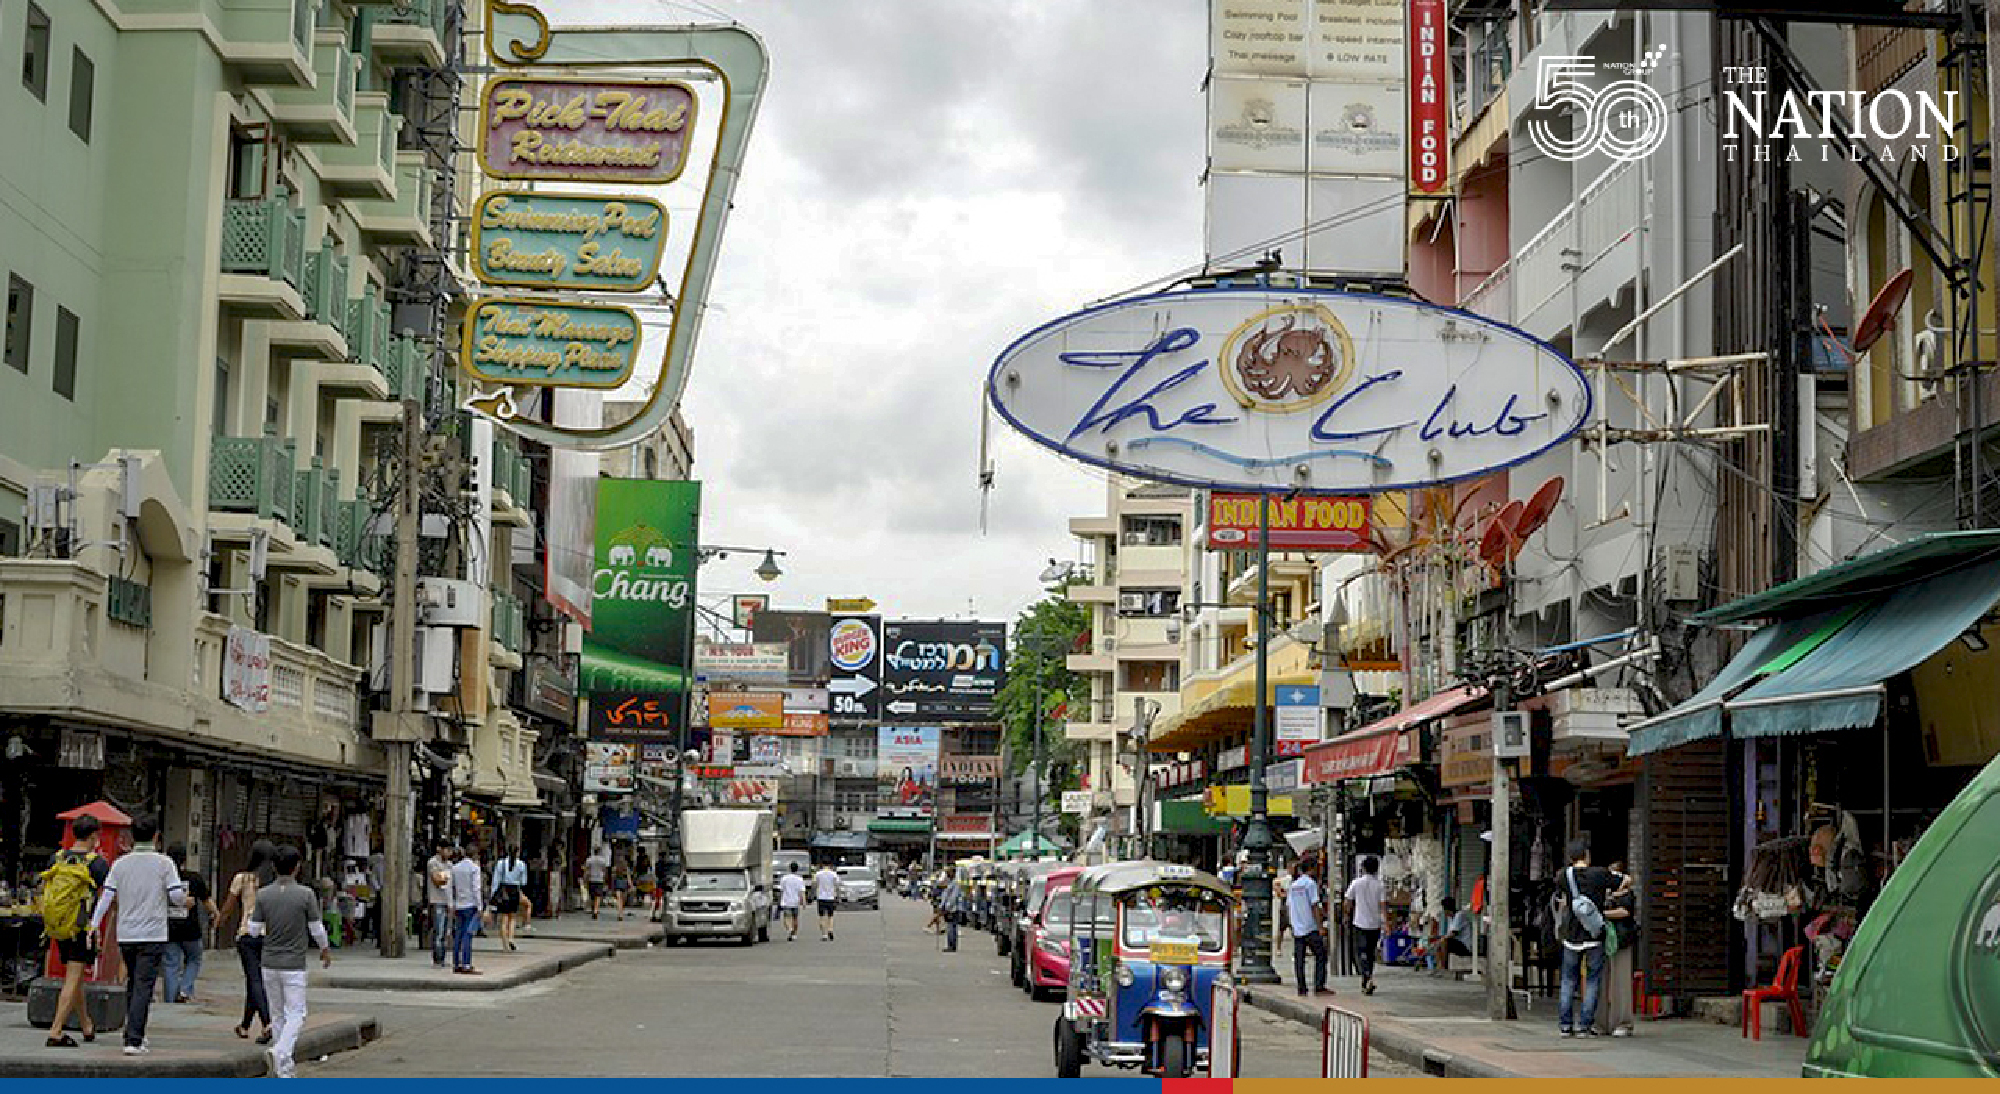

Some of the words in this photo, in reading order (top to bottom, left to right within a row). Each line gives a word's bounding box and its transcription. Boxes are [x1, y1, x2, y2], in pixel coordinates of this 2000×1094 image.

[1224, 10, 1274, 22] Swimming
[1277, 13, 1298, 21] Pool
[1319, 15, 1362, 24] Breakfast
[1223, 30, 1247, 41] Cozy
[1250, 31, 1285, 42] rooftop
[1289, 33, 1304, 42] bar
[1228, 50, 1249, 59] Thai
[1337, 54, 1360, 62] LOW
[1363, 55, 1388, 64] RATE
[1420, 10, 1436, 103] INDIAN
[509, 129, 662, 167] Restaurant
[1421, 119, 1437, 182] FOOD
[486, 237, 567, 279] Beauty
[573, 241, 643, 277] Salon
[480, 304, 532, 336] Thai
[532, 311, 635, 349] Massage
[474, 334, 562, 376] Shopping
[563, 341, 624, 370] Plaza
[1058, 326, 1239, 446] The
[1310, 370, 1549, 442] Club
[1213, 499, 1299, 528] INDIAN
[1304, 501, 1366, 529] FOOD
[592, 568, 690, 609] Chang
[835, 638, 870, 656] KING
[894, 734, 923, 745] ASIA
